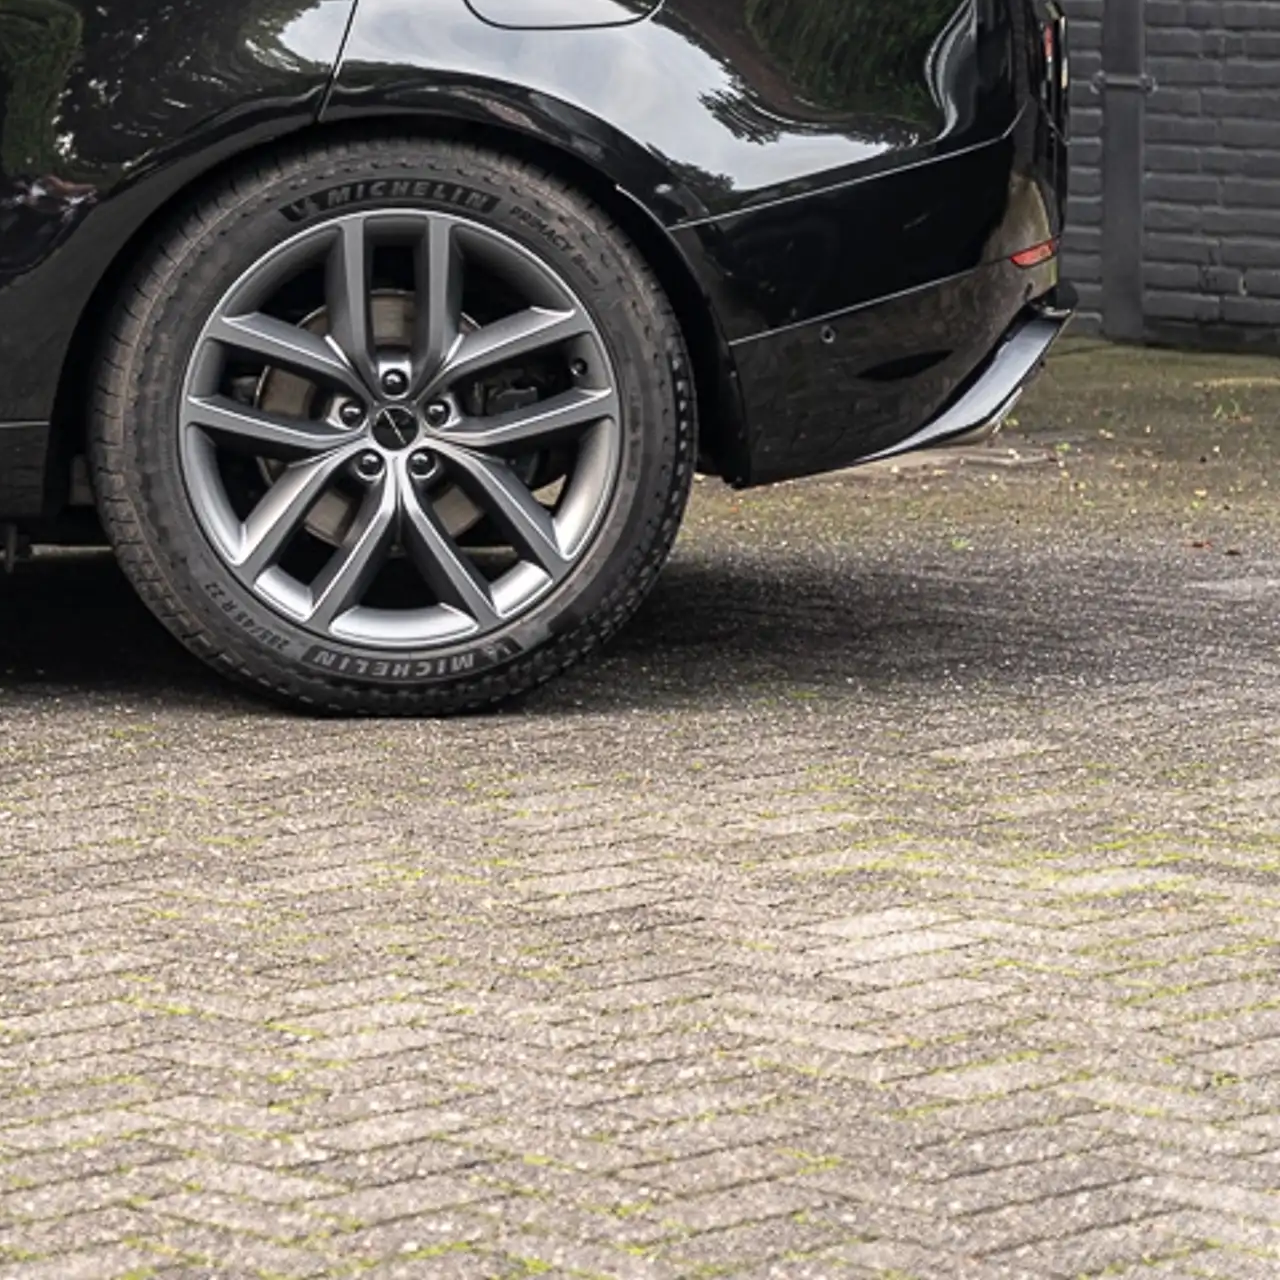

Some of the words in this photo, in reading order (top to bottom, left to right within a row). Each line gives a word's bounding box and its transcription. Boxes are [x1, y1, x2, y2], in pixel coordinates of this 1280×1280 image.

[326, 179, 488, 212] MICHELIN
[508, 205, 575, 254] PRIMACY
[312, 650, 475, 679] MICHELIN
